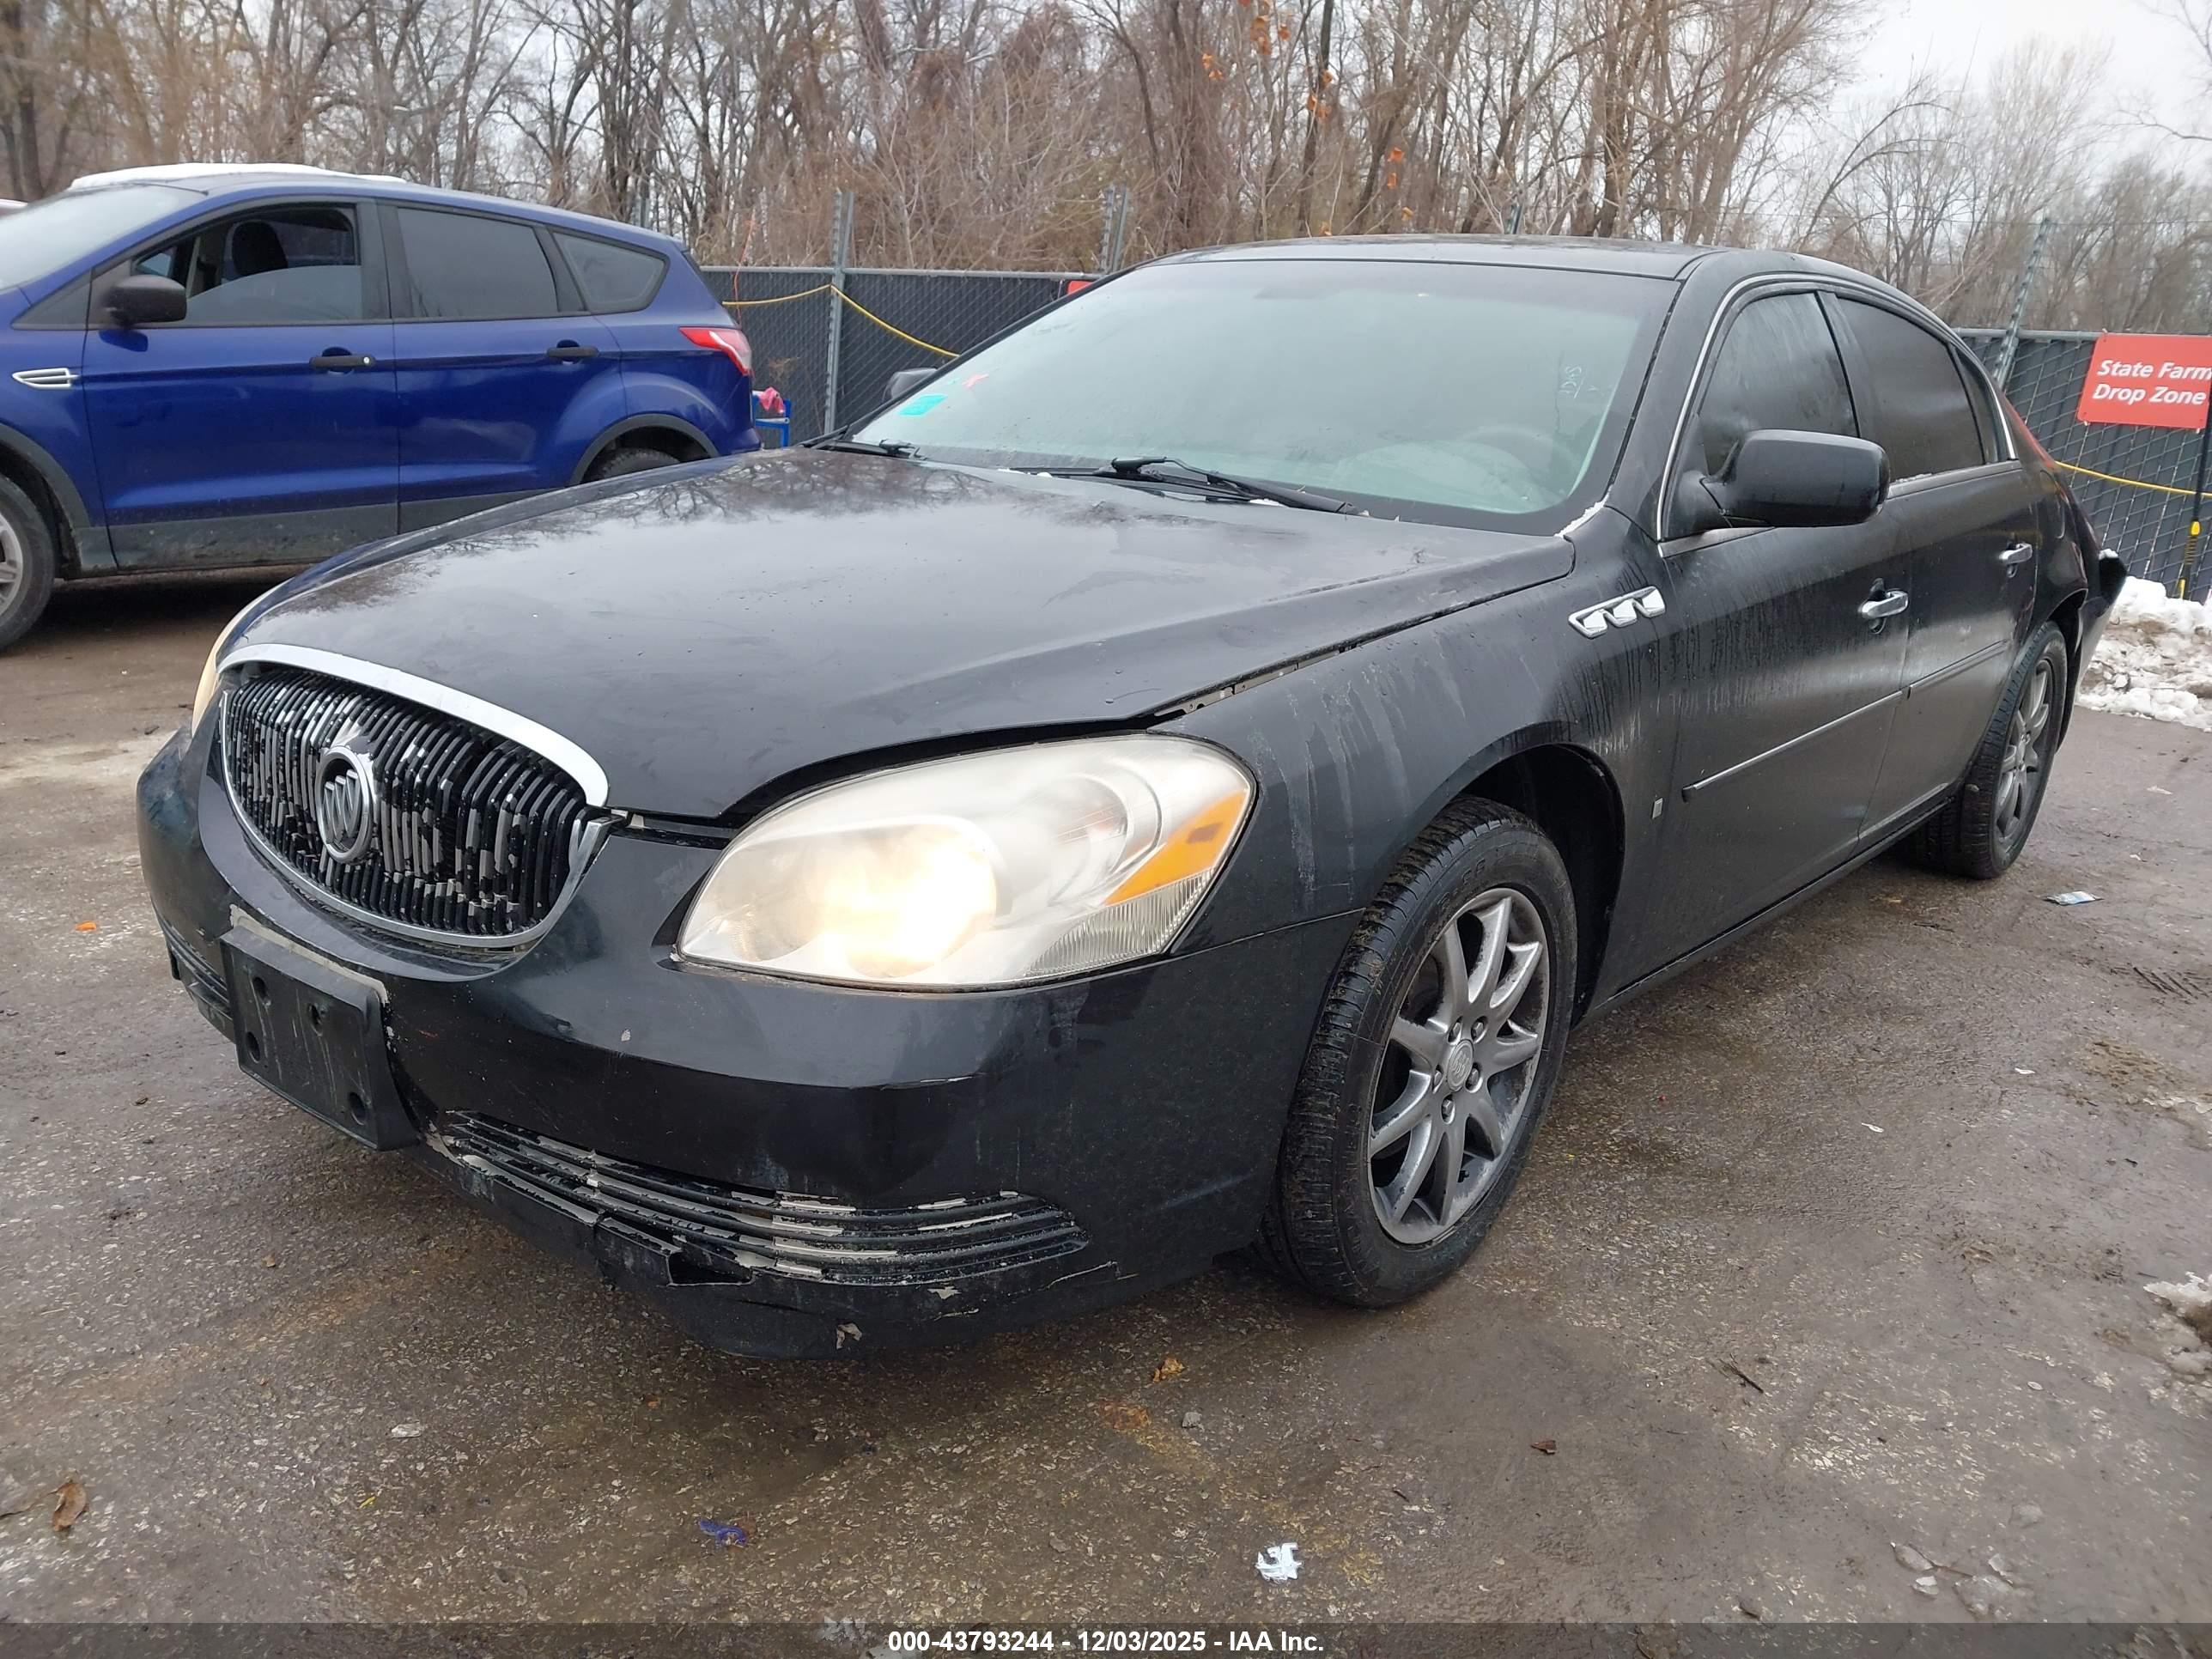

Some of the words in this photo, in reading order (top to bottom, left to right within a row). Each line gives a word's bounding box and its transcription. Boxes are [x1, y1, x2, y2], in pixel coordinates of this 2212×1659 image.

[2097, 360, 2154, 378] State
[2158, 362, 2212, 381] Farm
[2092, 383, 2146, 405] Drop
[2148, 386, 2207, 405] Zone
